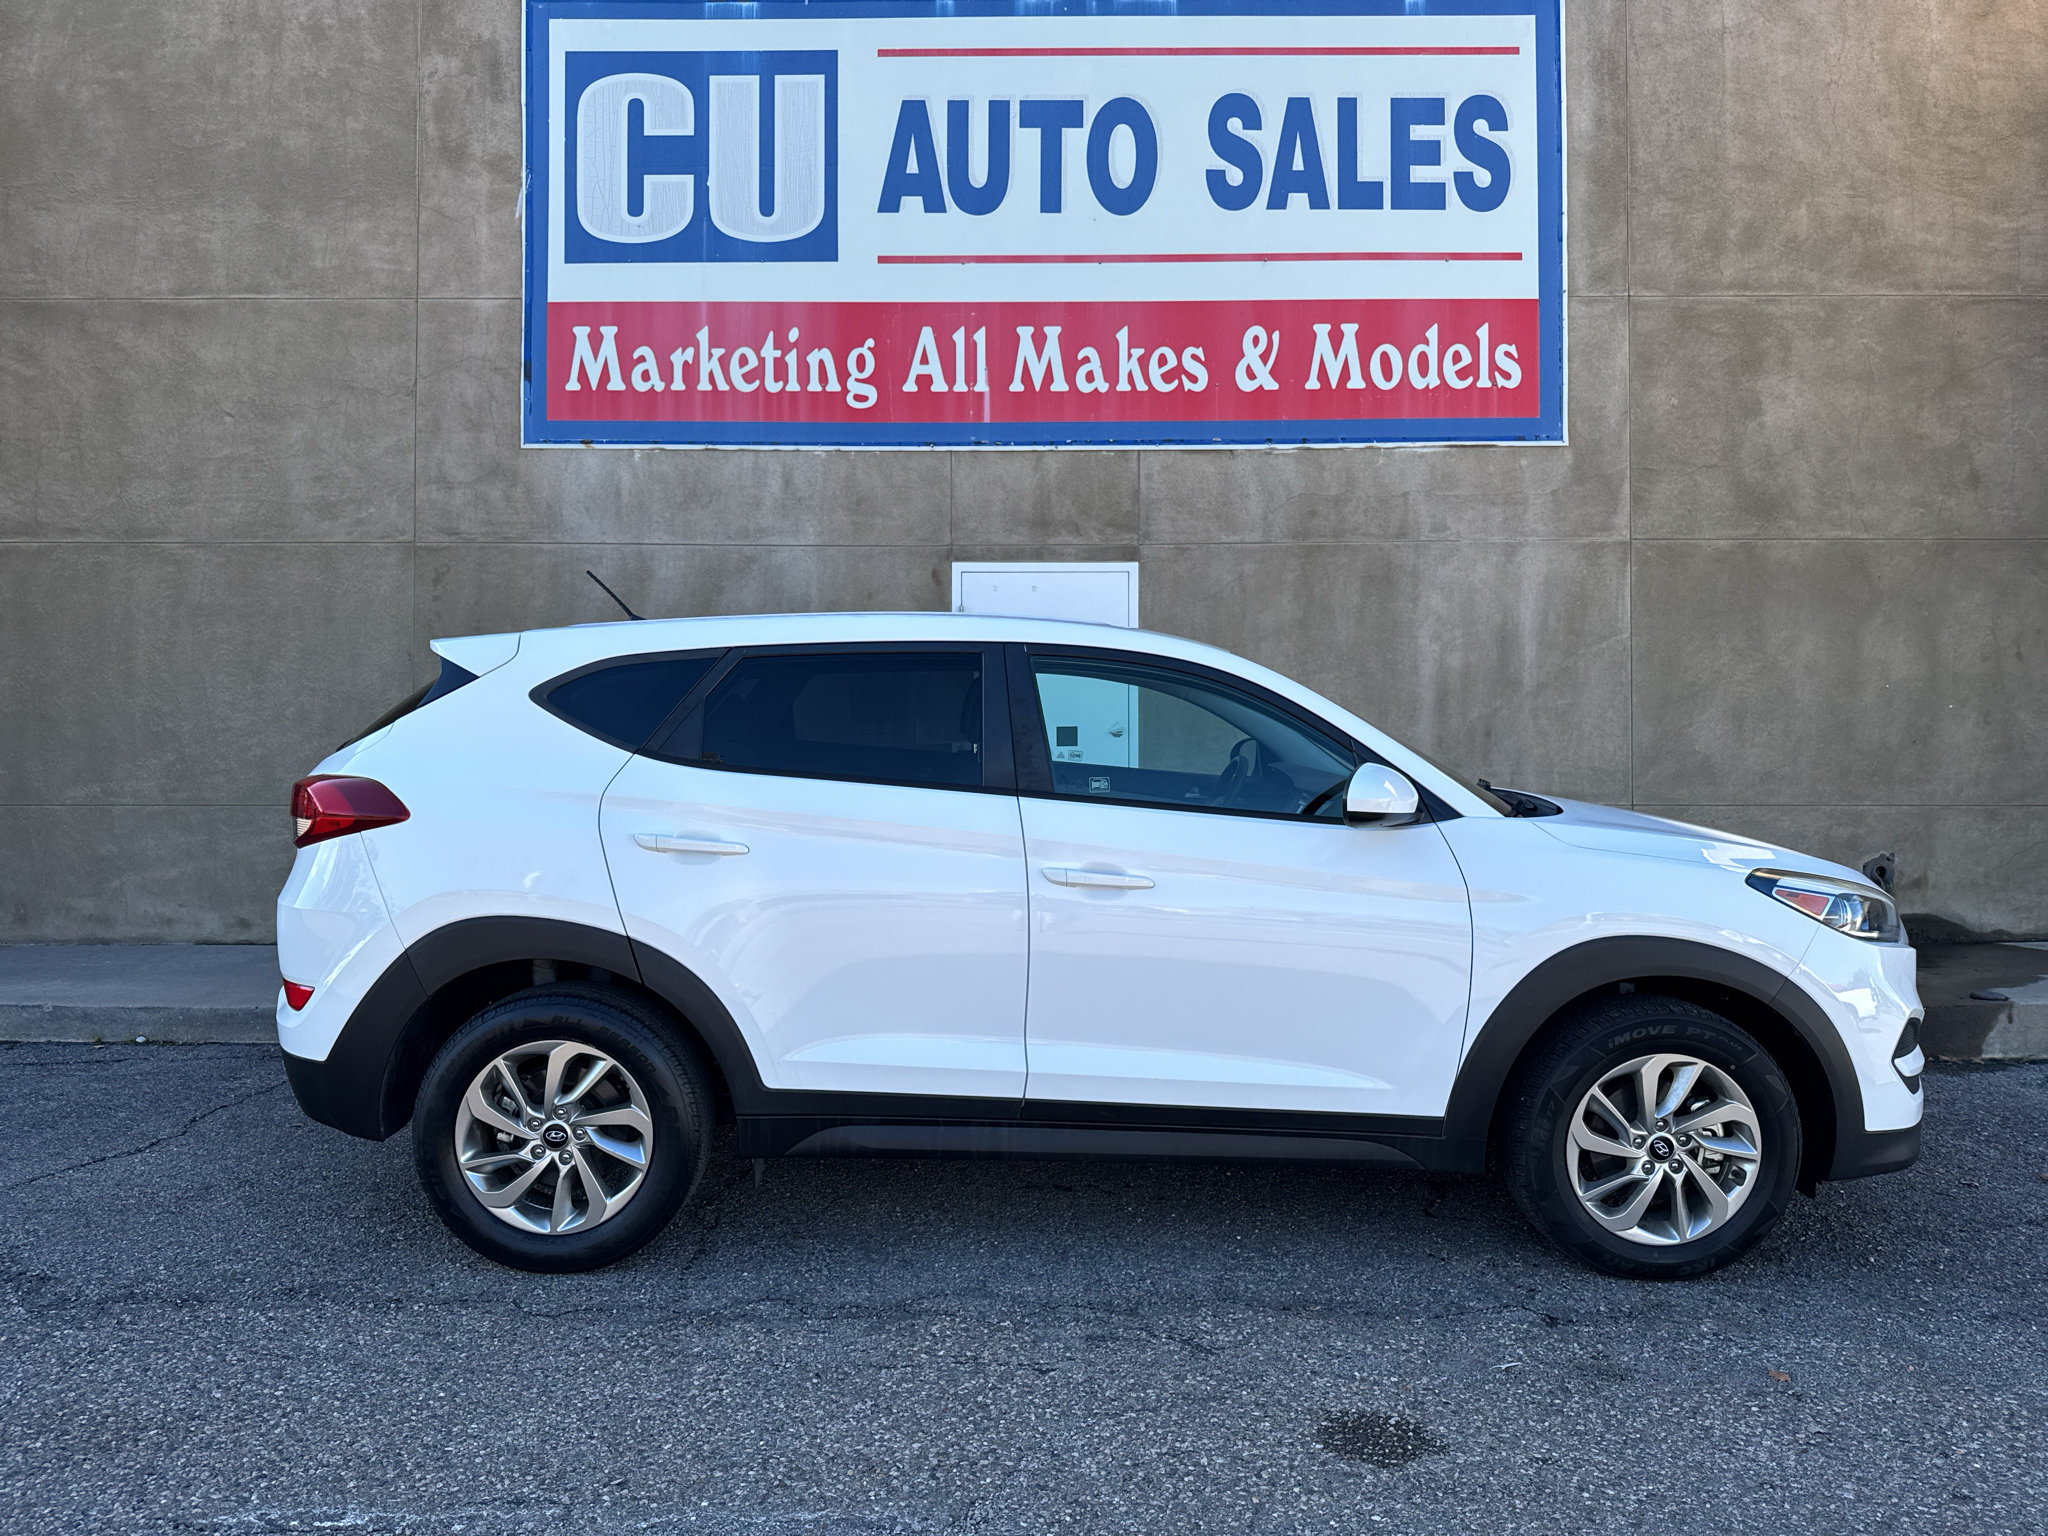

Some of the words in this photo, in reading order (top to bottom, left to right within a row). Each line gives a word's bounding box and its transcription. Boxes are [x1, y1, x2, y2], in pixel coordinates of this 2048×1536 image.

[576, 72, 827, 244] CU
[876, 96, 1161, 217] AUTO
[1204, 92, 1513, 214] SALES
[564, 324, 879, 410] Marketing
[901, 324, 990, 393] All
[1008, 324, 1210, 394] Makes
[1233, 324, 1281, 393] &
[1304, 321, 1523, 391] Models
[1607, 1024, 1679, 1050] iMOVE
[1685, 1026, 1717, 1041] PT
